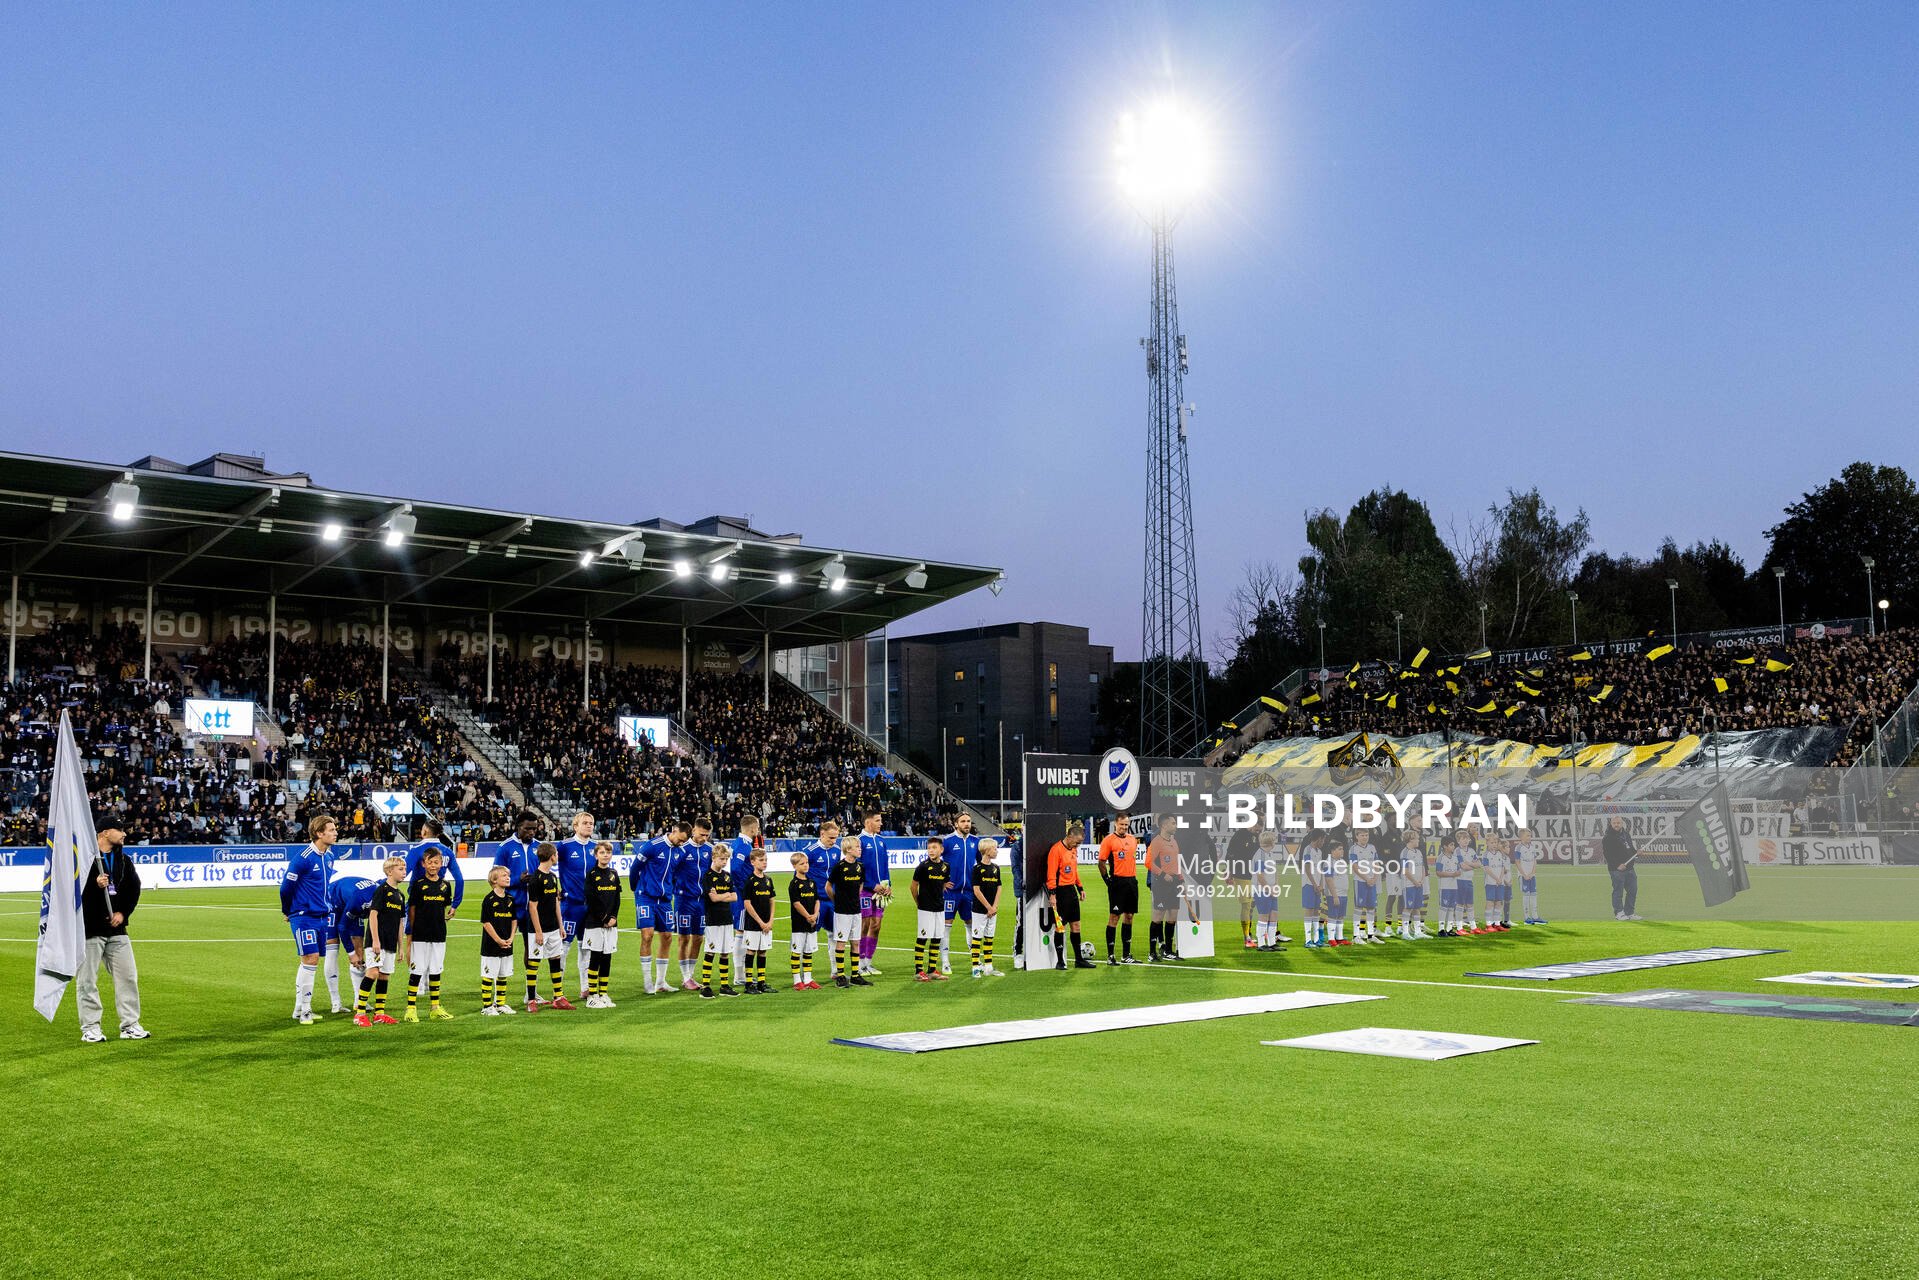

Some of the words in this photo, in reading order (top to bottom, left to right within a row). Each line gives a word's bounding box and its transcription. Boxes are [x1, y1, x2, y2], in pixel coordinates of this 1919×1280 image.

[1499, 652, 1521, 664] ETT
[204, 705, 231, 728] ett
[1036, 767, 1090, 785] UNIBET
[1149, 770, 1196, 787] UNIBET
[1592, 816, 1668, 838] ADRIG
[222, 852, 285, 861] HYDROSCAND
[902, 851, 916, 864] liv
[1813, 840, 1874, 860] Smith
[165, 864, 195, 883] Ett
[202, 864, 226, 881] liv
[232, 865, 253, 881] ett
